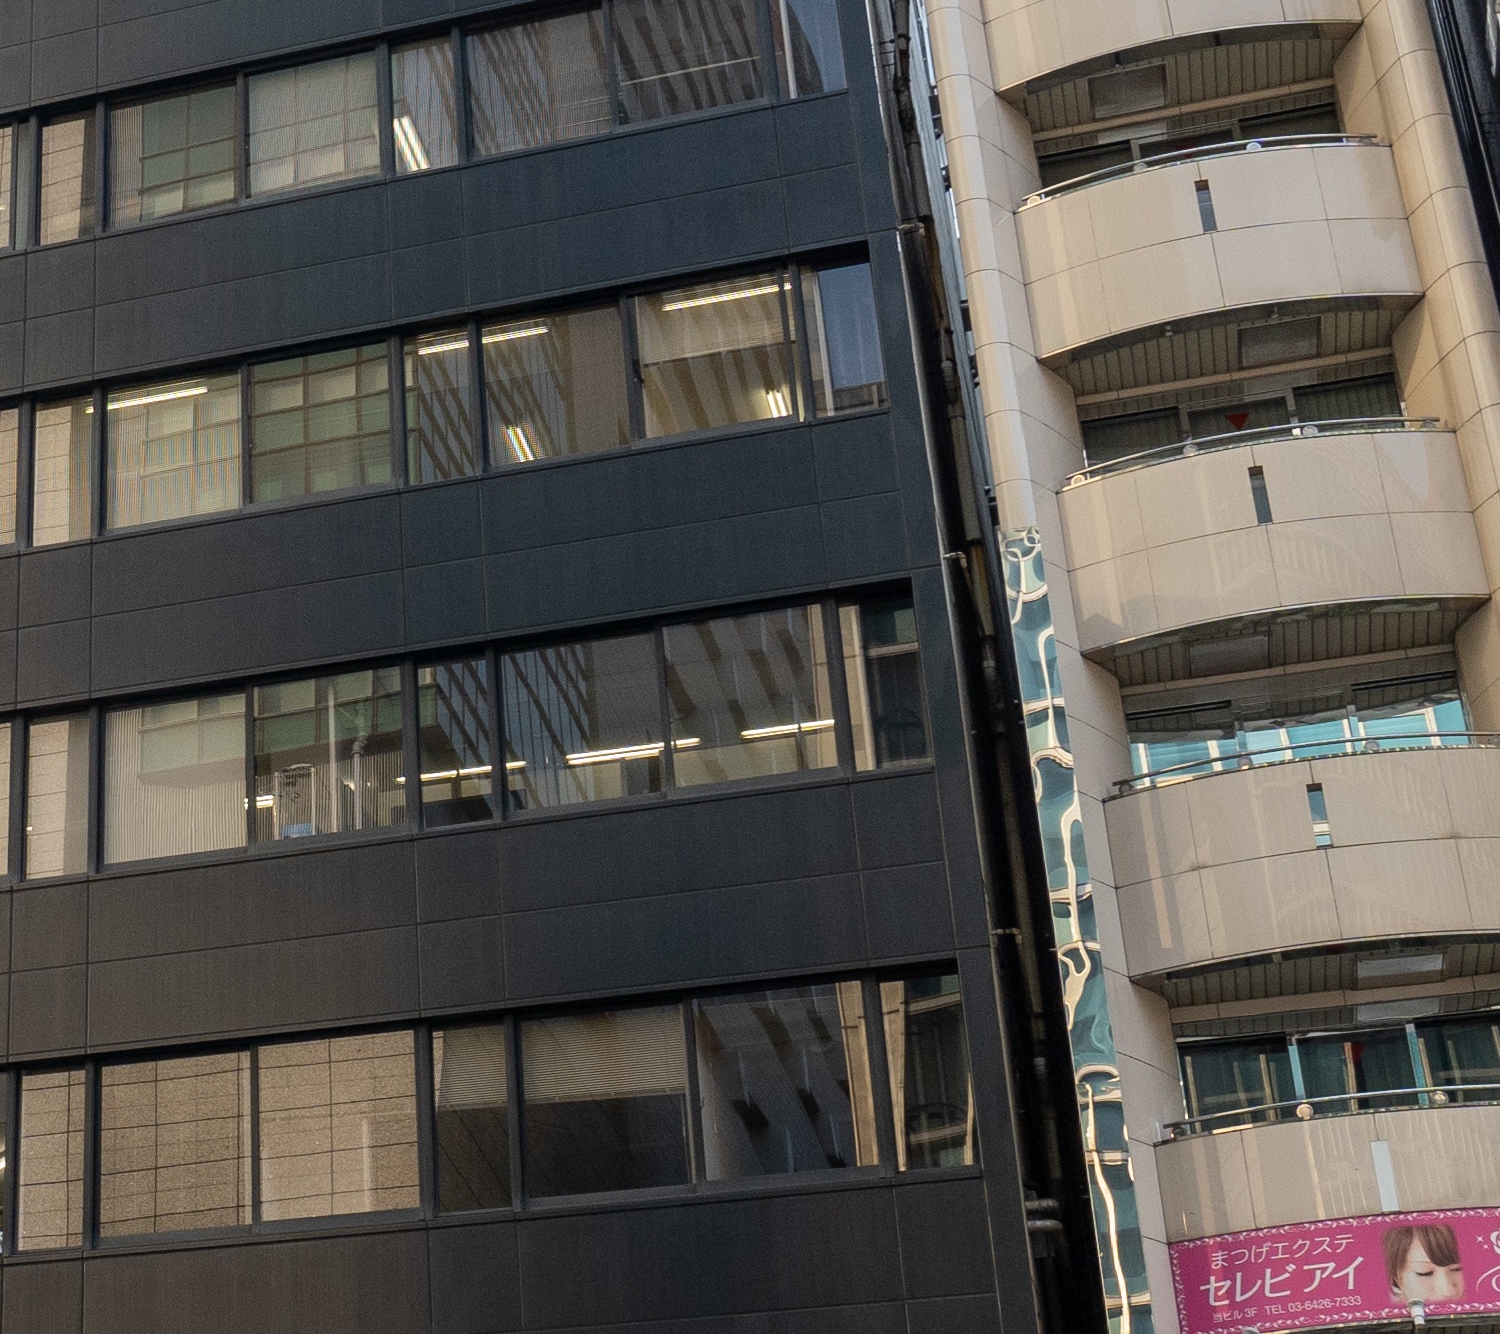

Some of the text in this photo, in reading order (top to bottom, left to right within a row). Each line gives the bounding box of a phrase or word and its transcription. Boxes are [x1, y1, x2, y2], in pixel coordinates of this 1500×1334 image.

[1211, 1233, 1355, 1270] まつげエクステ
[1212, 1295, 1362, 1323] 当ビル 3F TEL 03-6426-7333
